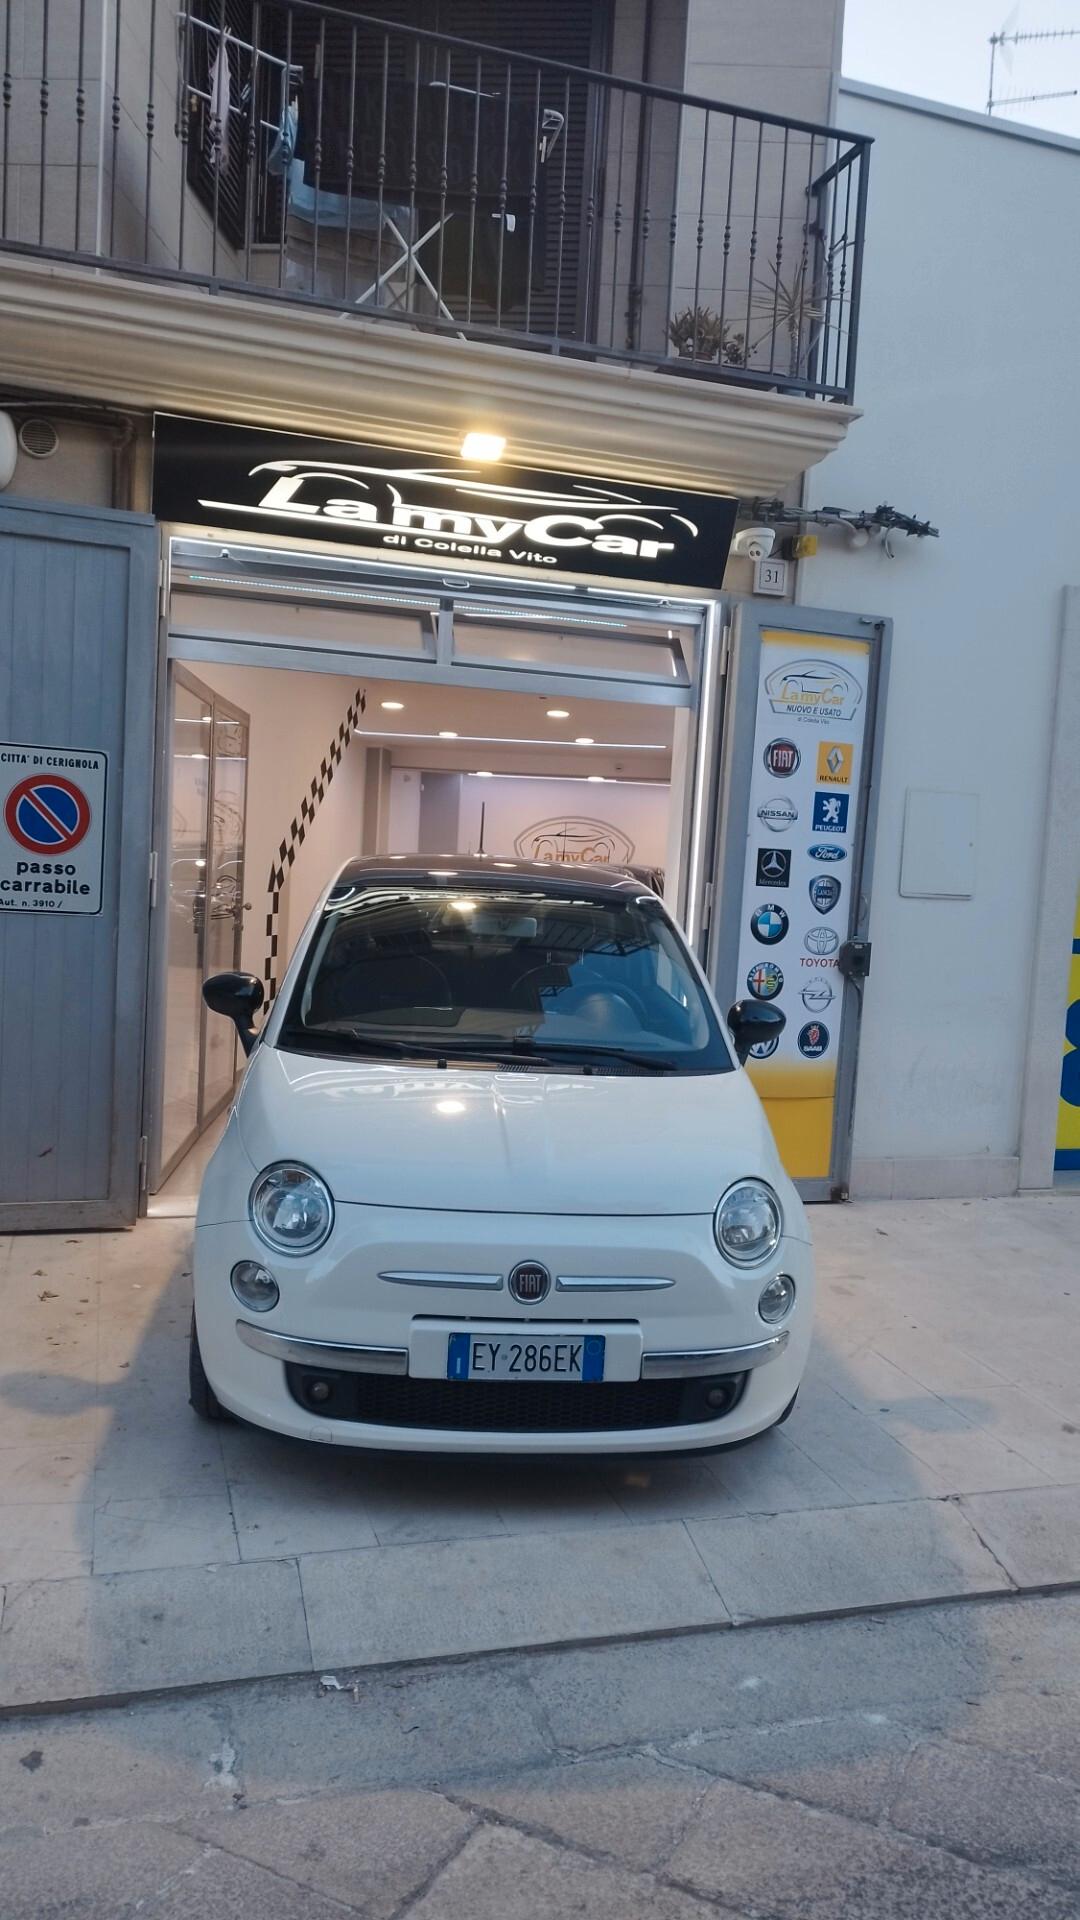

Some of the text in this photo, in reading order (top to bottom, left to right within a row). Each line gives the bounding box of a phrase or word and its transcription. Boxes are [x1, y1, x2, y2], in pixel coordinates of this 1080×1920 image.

[383, 535, 557, 564] di Colella Vito
[765, 569, 779, 583] 31
[786, 705, 812, 714] NUOVO
[820, 708, 842, 716] USATO
[33, 756, 43, 765] DI
[46, 757, 99, 770] CERIGNOLA
[773, 750, 794, 767] FIAT
[819, 775, 849, 783] RENAULT
[760, 809, 795, 818] NISSAN
[815, 824, 845, 832] PEUGEOT
[814, 846, 840, 859] Ford
[16, 861, 76, 876] passo
[0, 879, 91, 895] carrabile
[758, 878, 787, 887] Mercedes
[32, 899, 55, 907] 3910
[754, 904, 787, 918] BMW
[800, 958, 840, 968] TOYOTA
[519, 1274, 541, 1293] FIAT
[472, 1343, 501, 1371] EY
[509, 1344, 583, 1372] 286EK
